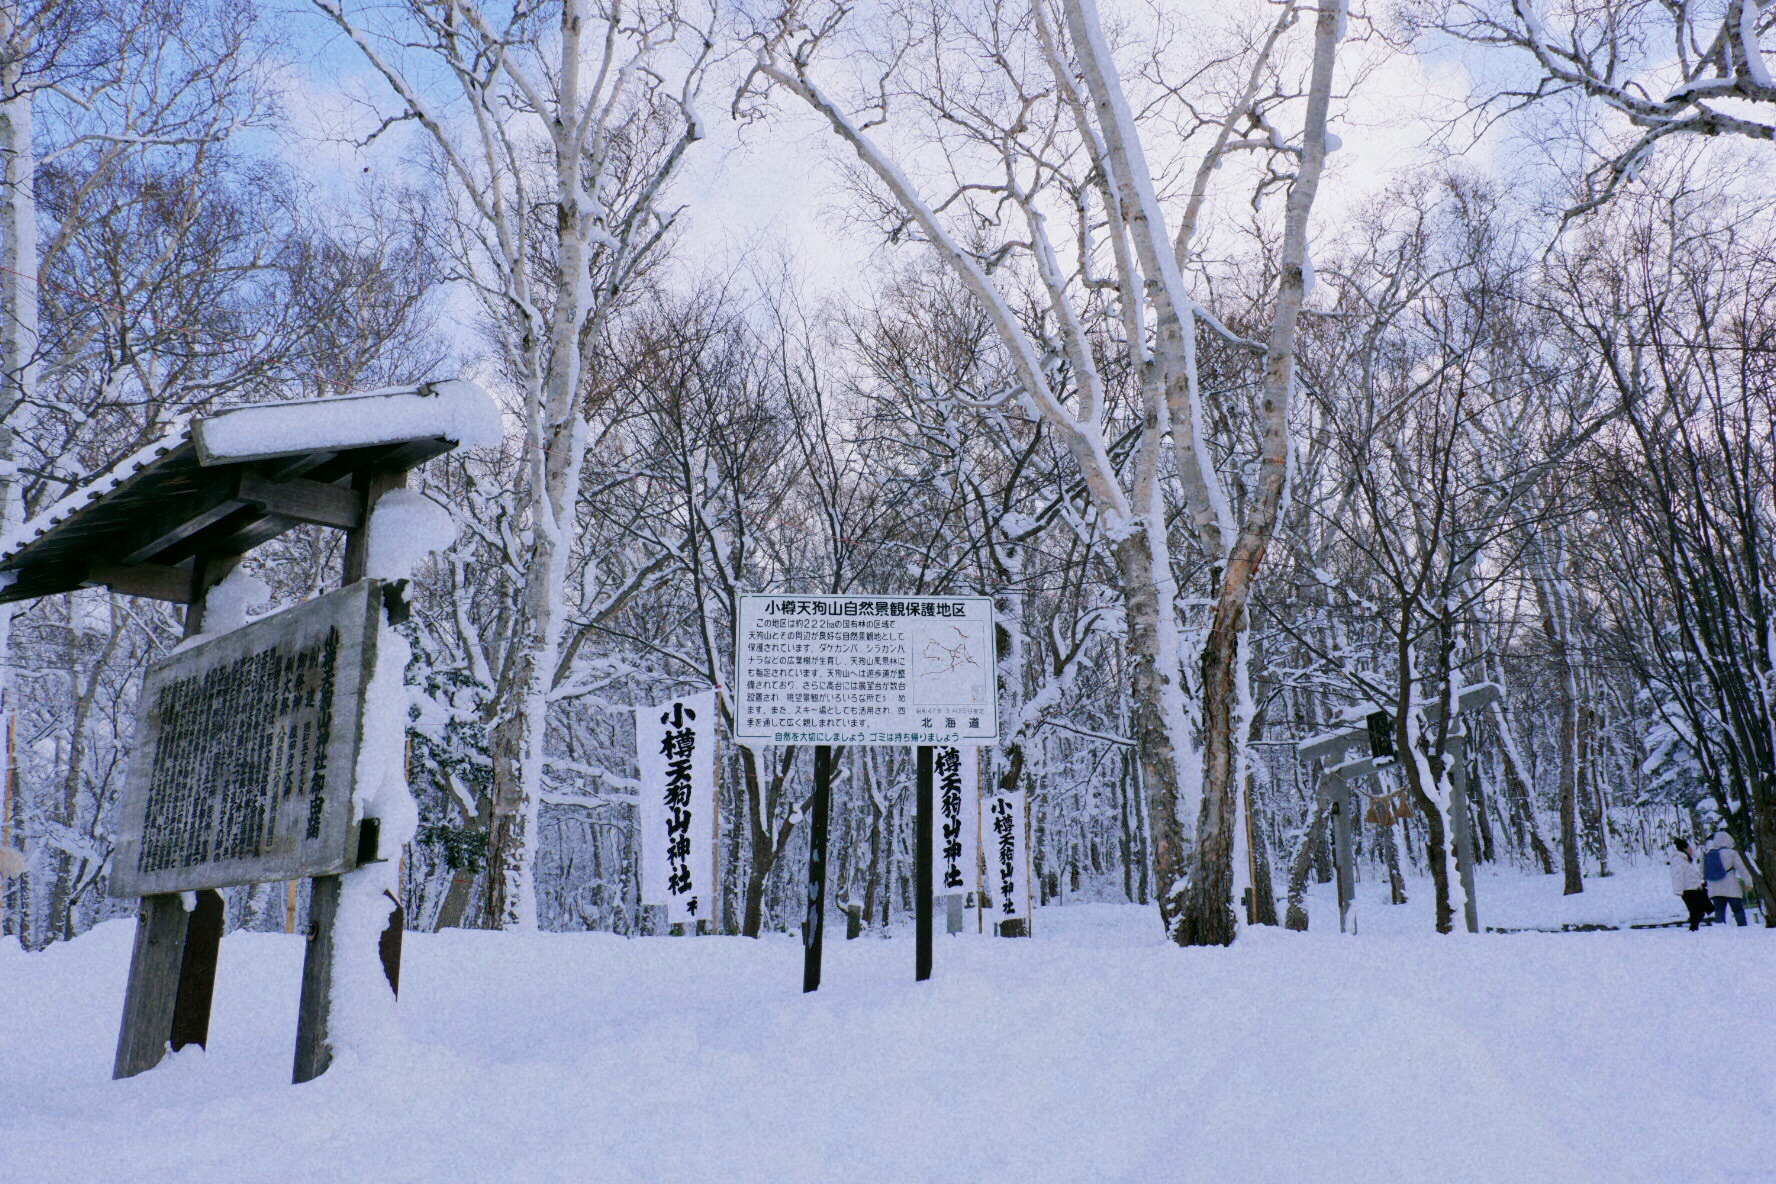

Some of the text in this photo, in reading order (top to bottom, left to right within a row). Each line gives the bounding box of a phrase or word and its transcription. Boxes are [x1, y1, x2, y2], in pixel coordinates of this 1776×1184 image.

[765, 600, 966, 617] 小樽天狗山自然景観保護地区
[748, 631, 905, 641] 天狗山とその周辺が良好な自然景観地として
[747, 718, 871, 728] 季を通して広く親しまれています。
[921, 717, 980, 729] 北海道
[775, 732, 959, 743] 自然を大切にしましょう ゴミは持ち帰りましょう
[660, 702, 697, 895] 小樽天狗山神社
[934, 746, 964, 889] 樽天狗山神社
[991, 798, 1016, 915] 小樽天狗山神社
